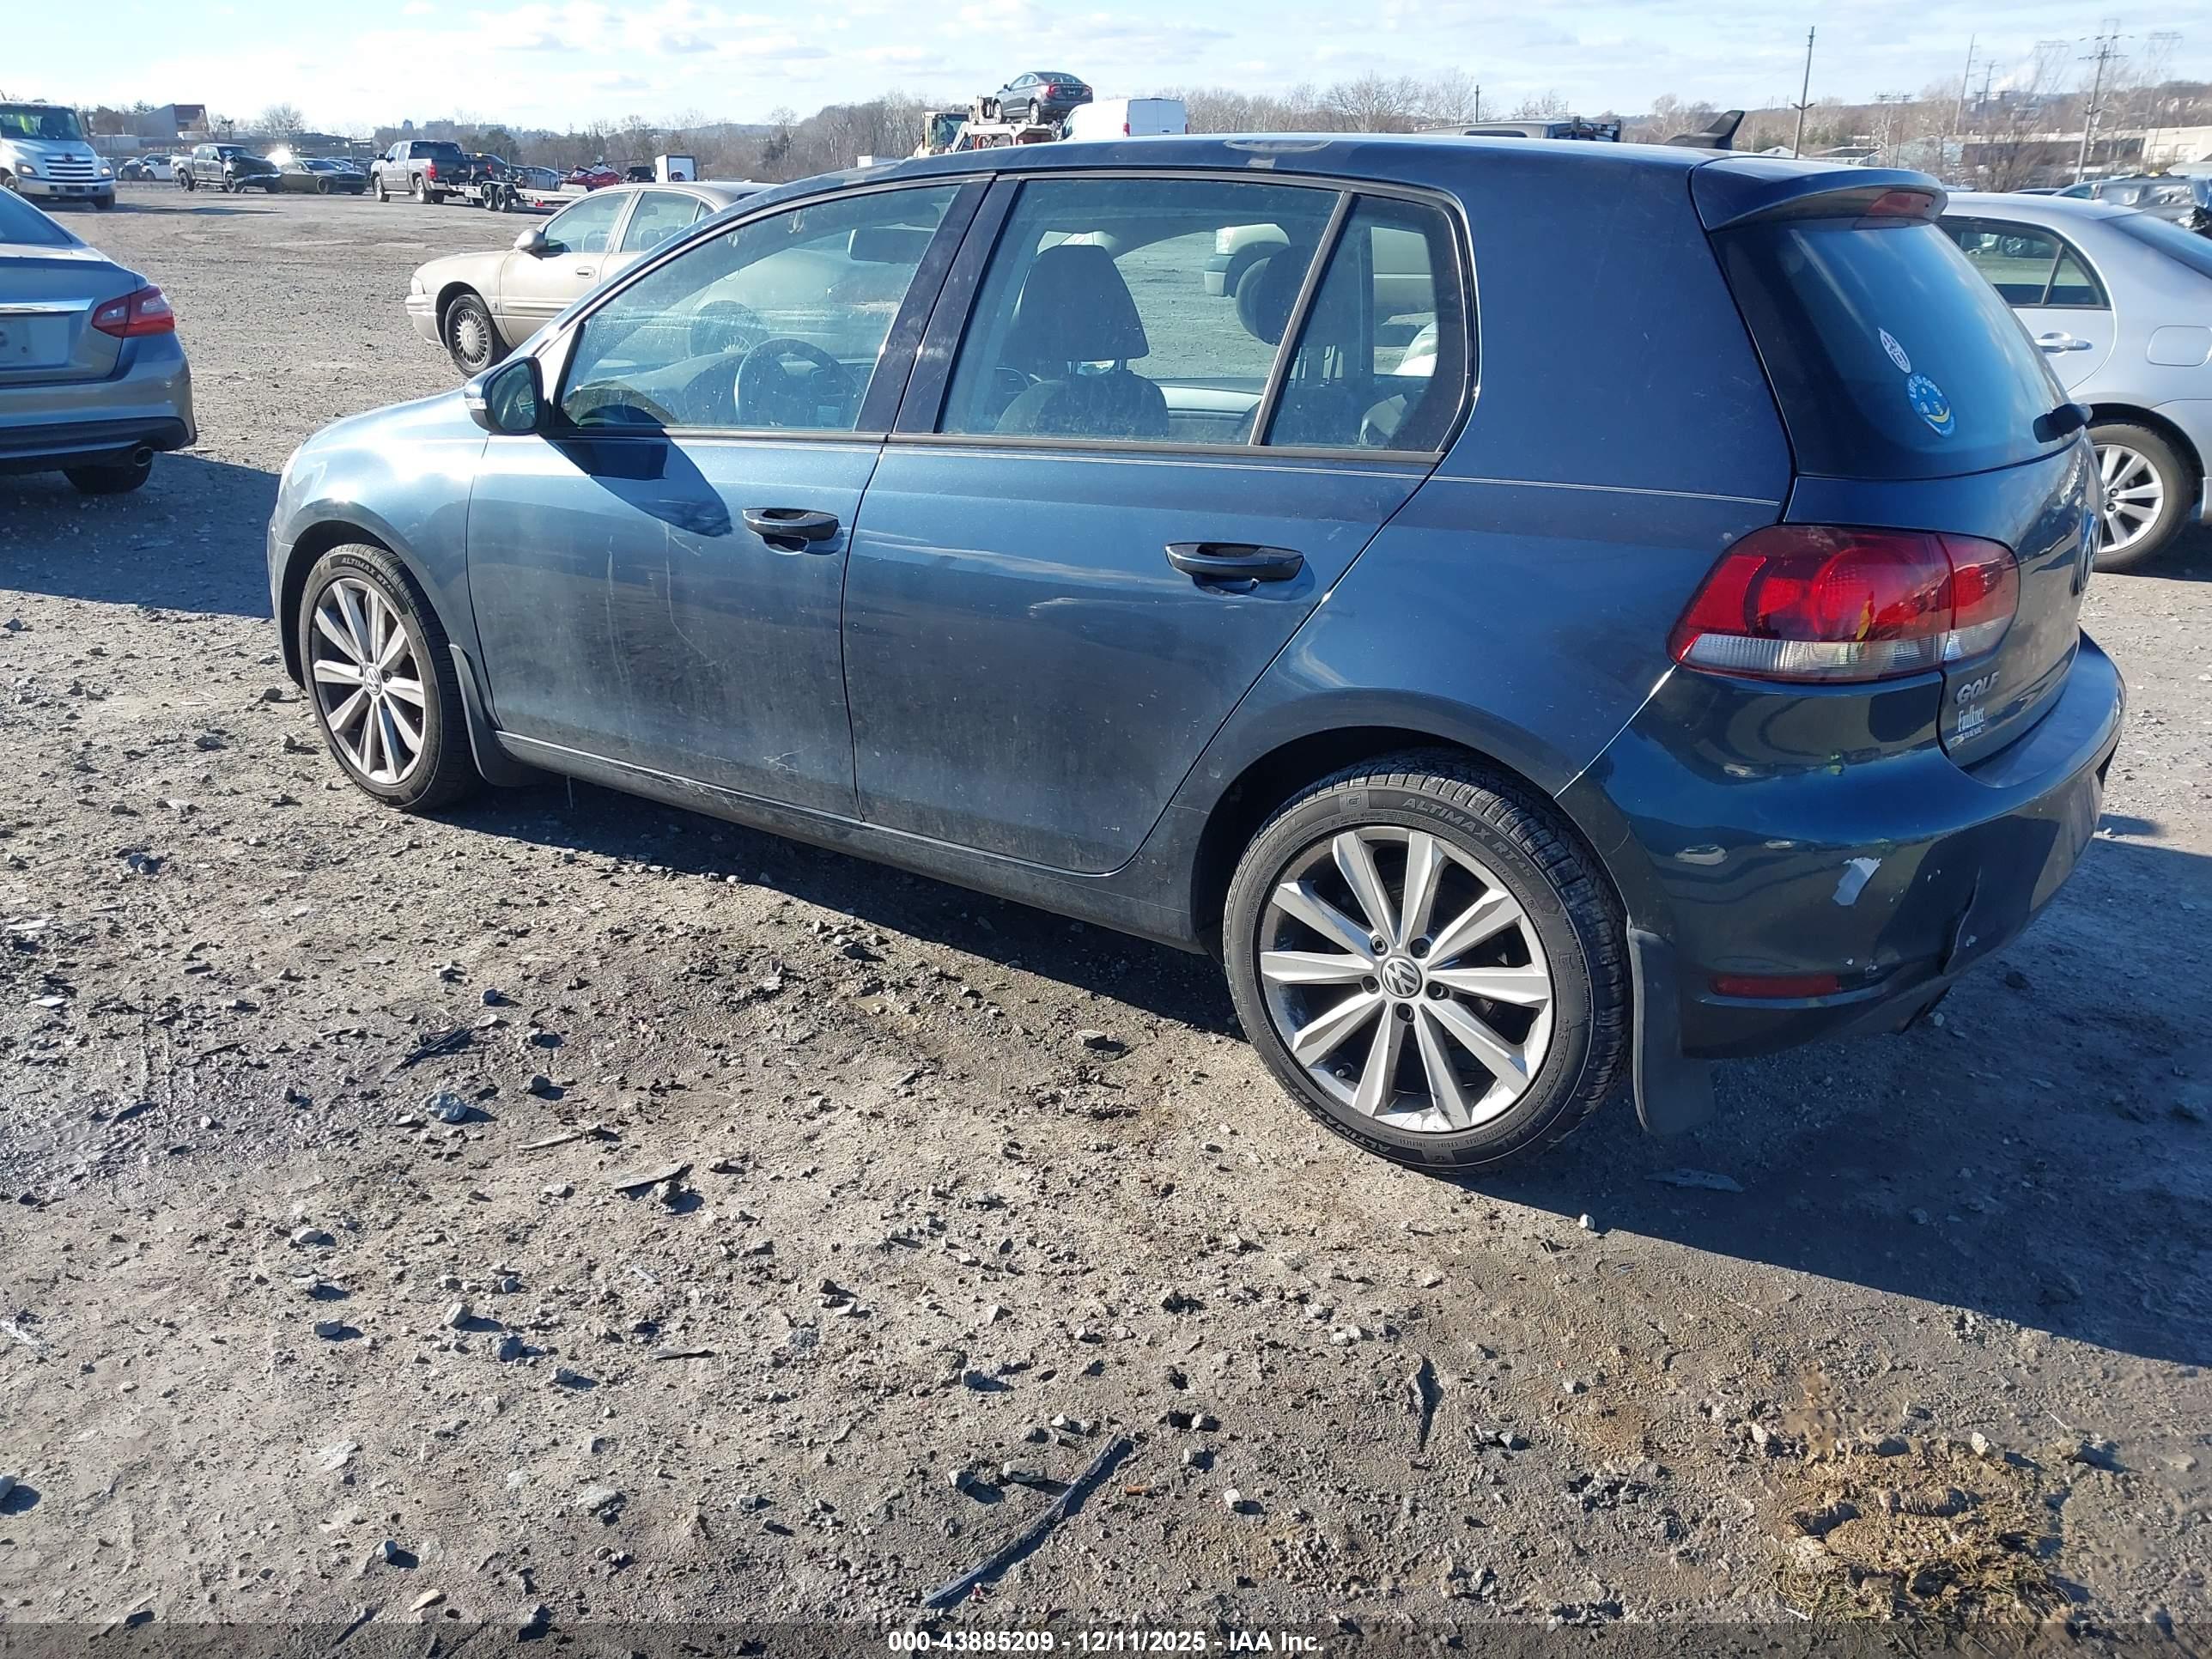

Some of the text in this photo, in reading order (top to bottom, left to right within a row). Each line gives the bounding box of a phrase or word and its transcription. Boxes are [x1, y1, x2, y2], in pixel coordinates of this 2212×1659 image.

[341, 556, 375, 575] ALTIMAX
[1957, 671, 2000, 705] GOLF
[1958, 705, 1984, 732] Faulkner
[1401, 798, 1491, 841] ALTIMAX
[1312, 1107, 1392, 1153] ALTIMAX
